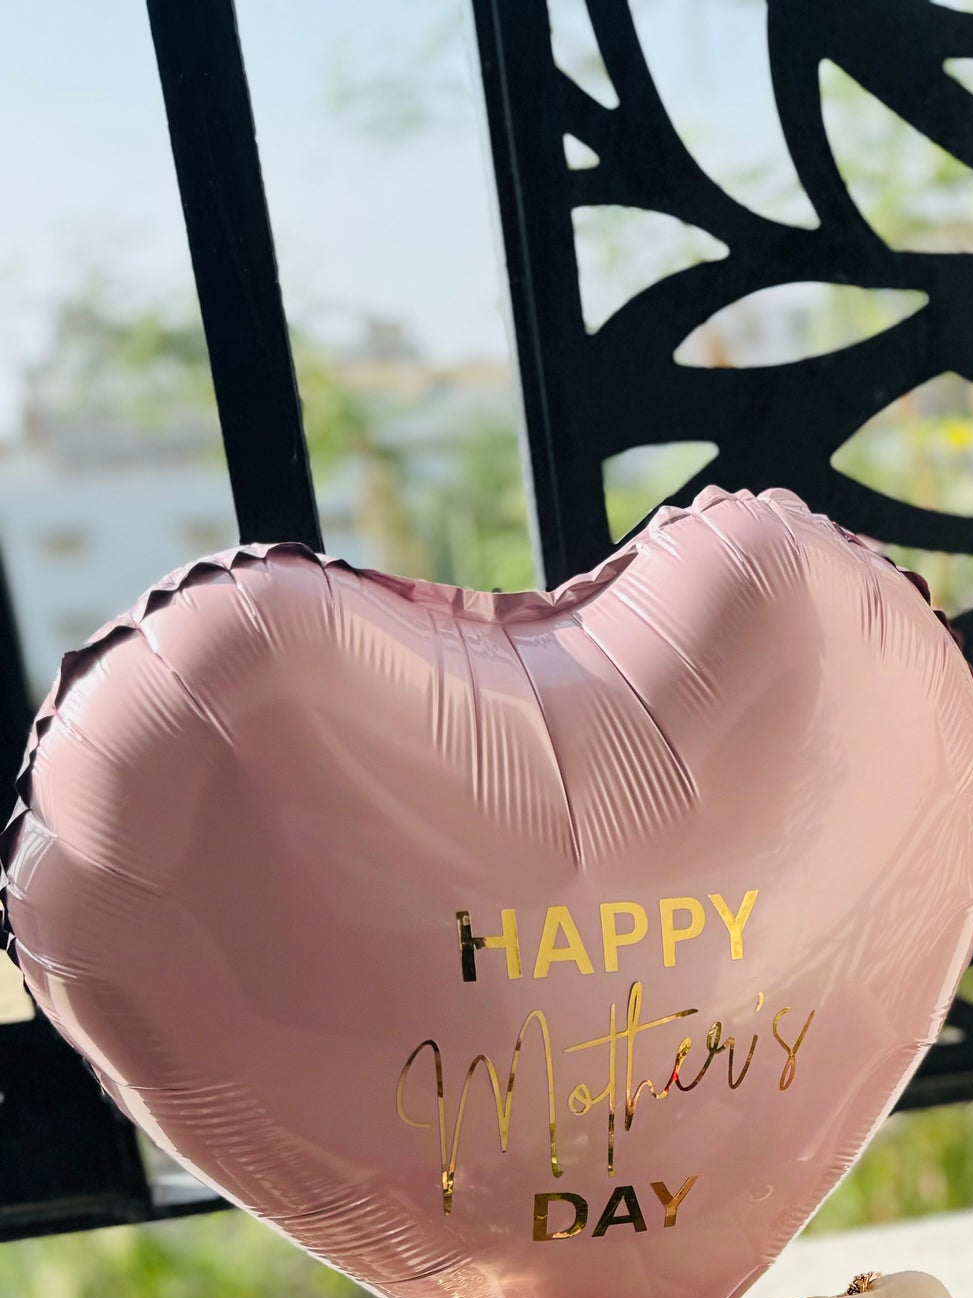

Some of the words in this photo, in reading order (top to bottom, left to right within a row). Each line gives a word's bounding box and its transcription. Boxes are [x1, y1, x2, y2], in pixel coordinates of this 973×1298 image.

[456, 889, 759, 982] HAPPY
[397, 981, 815, 1216] Mother's
[532, 1175, 699, 1241] DAY
